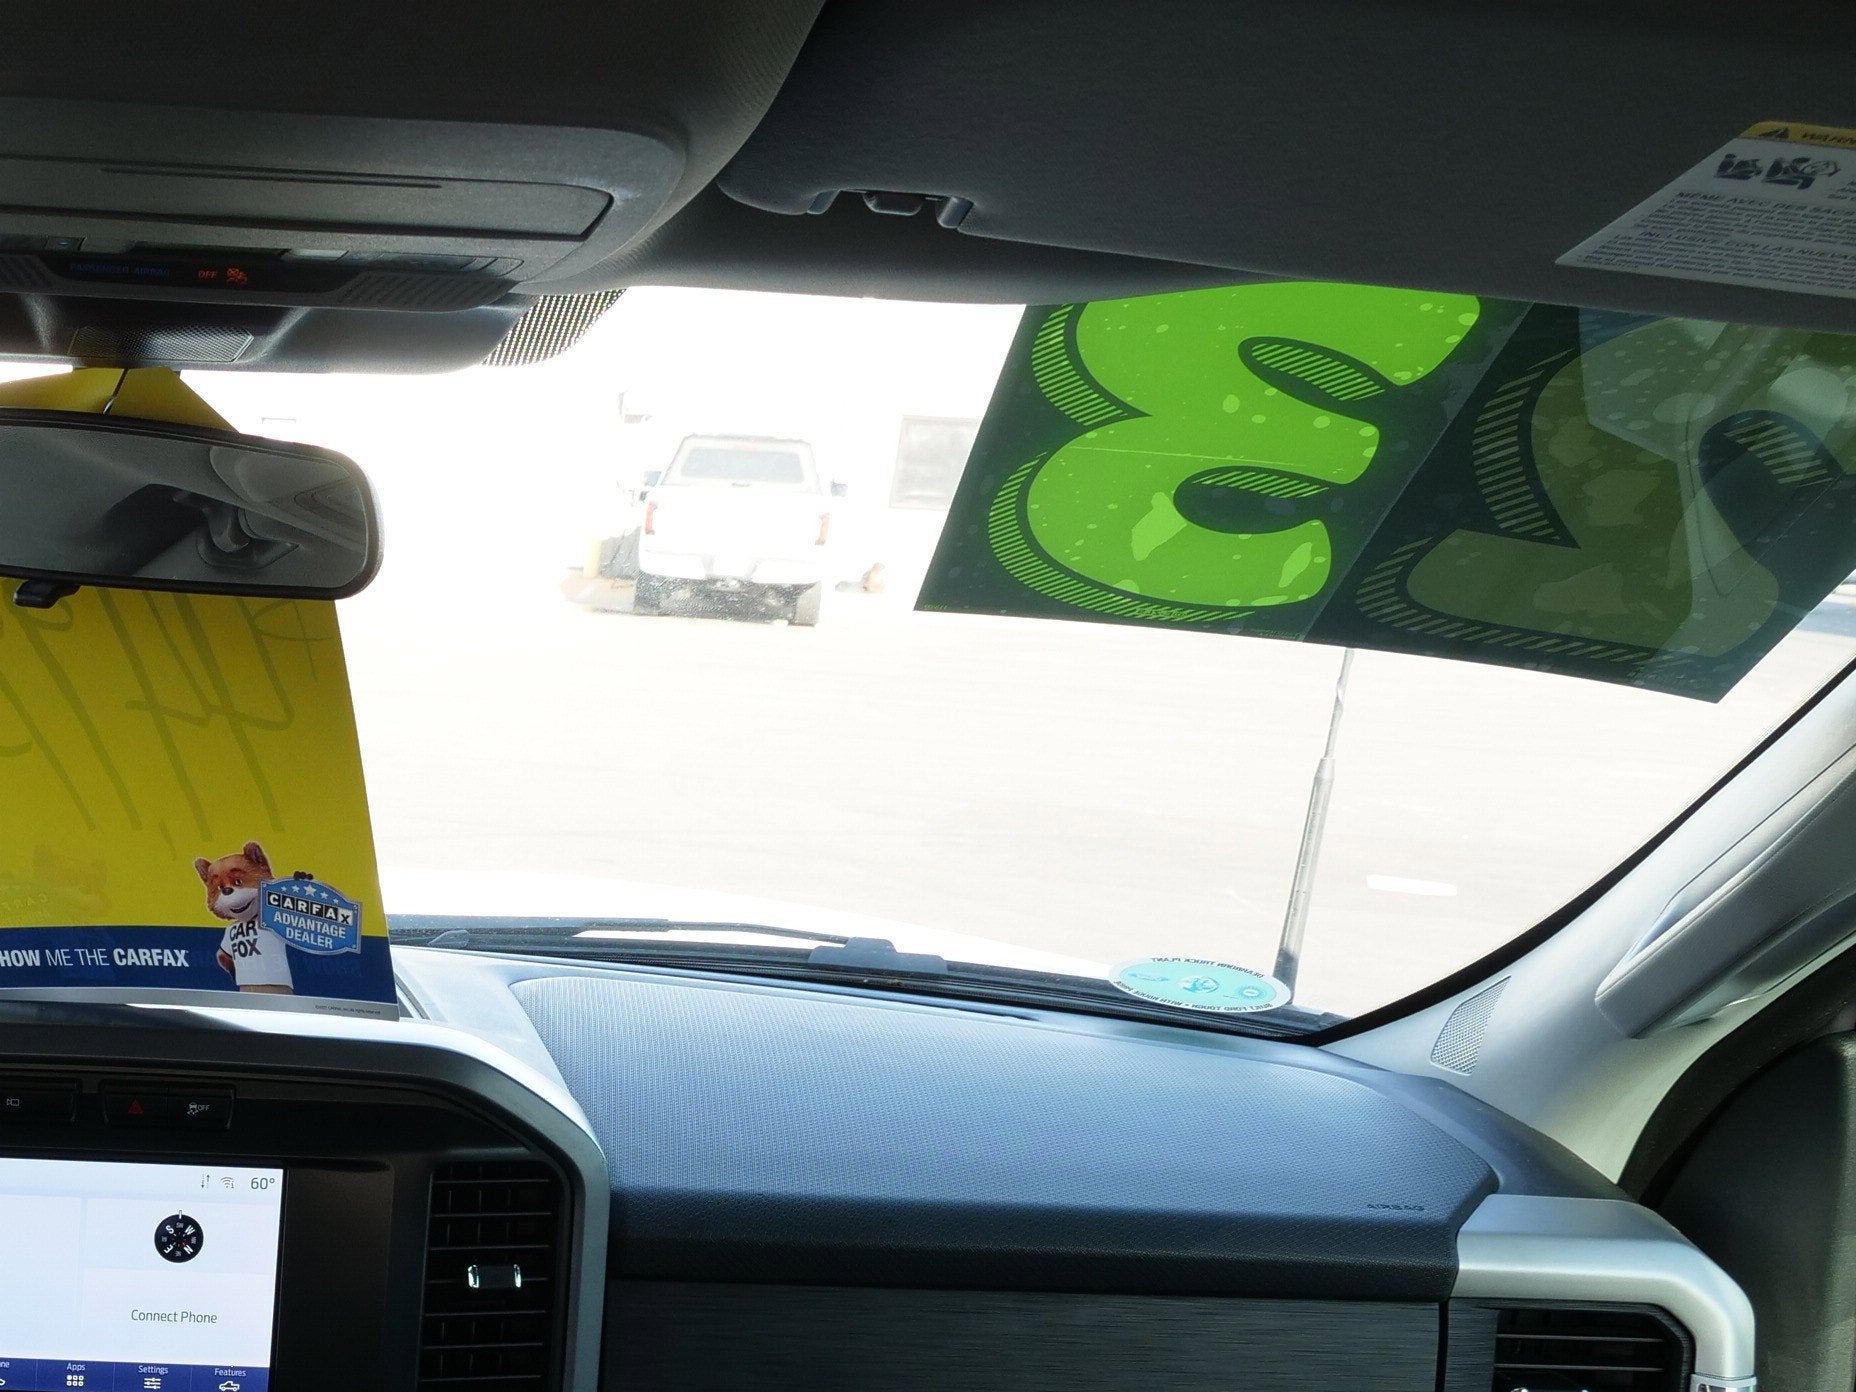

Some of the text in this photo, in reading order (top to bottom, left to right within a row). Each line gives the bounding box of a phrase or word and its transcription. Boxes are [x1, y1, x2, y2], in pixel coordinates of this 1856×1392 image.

[196, 269, 217, 280] OFF
[268, 892, 352, 926] CARFAX
[229, 920, 258, 942] CAR
[273, 911, 346, 939] ADVANTAGE
[285, 926, 333, 949] DEALER
[231, 937, 262, 960] FOX
[45, 949, 73, 966] ME
[74, 948, 110, 966] THE
[112, 948, 189, 967] CARFAX
[250, 1176, 276, 1192] 60°
[131, 1309, 218, 1325] Connect Phone
[66, 1362, 86, 1373] Apps
[138, 1364, 169, 1376] Settings
[214, 1367, 247, 1378] Features
